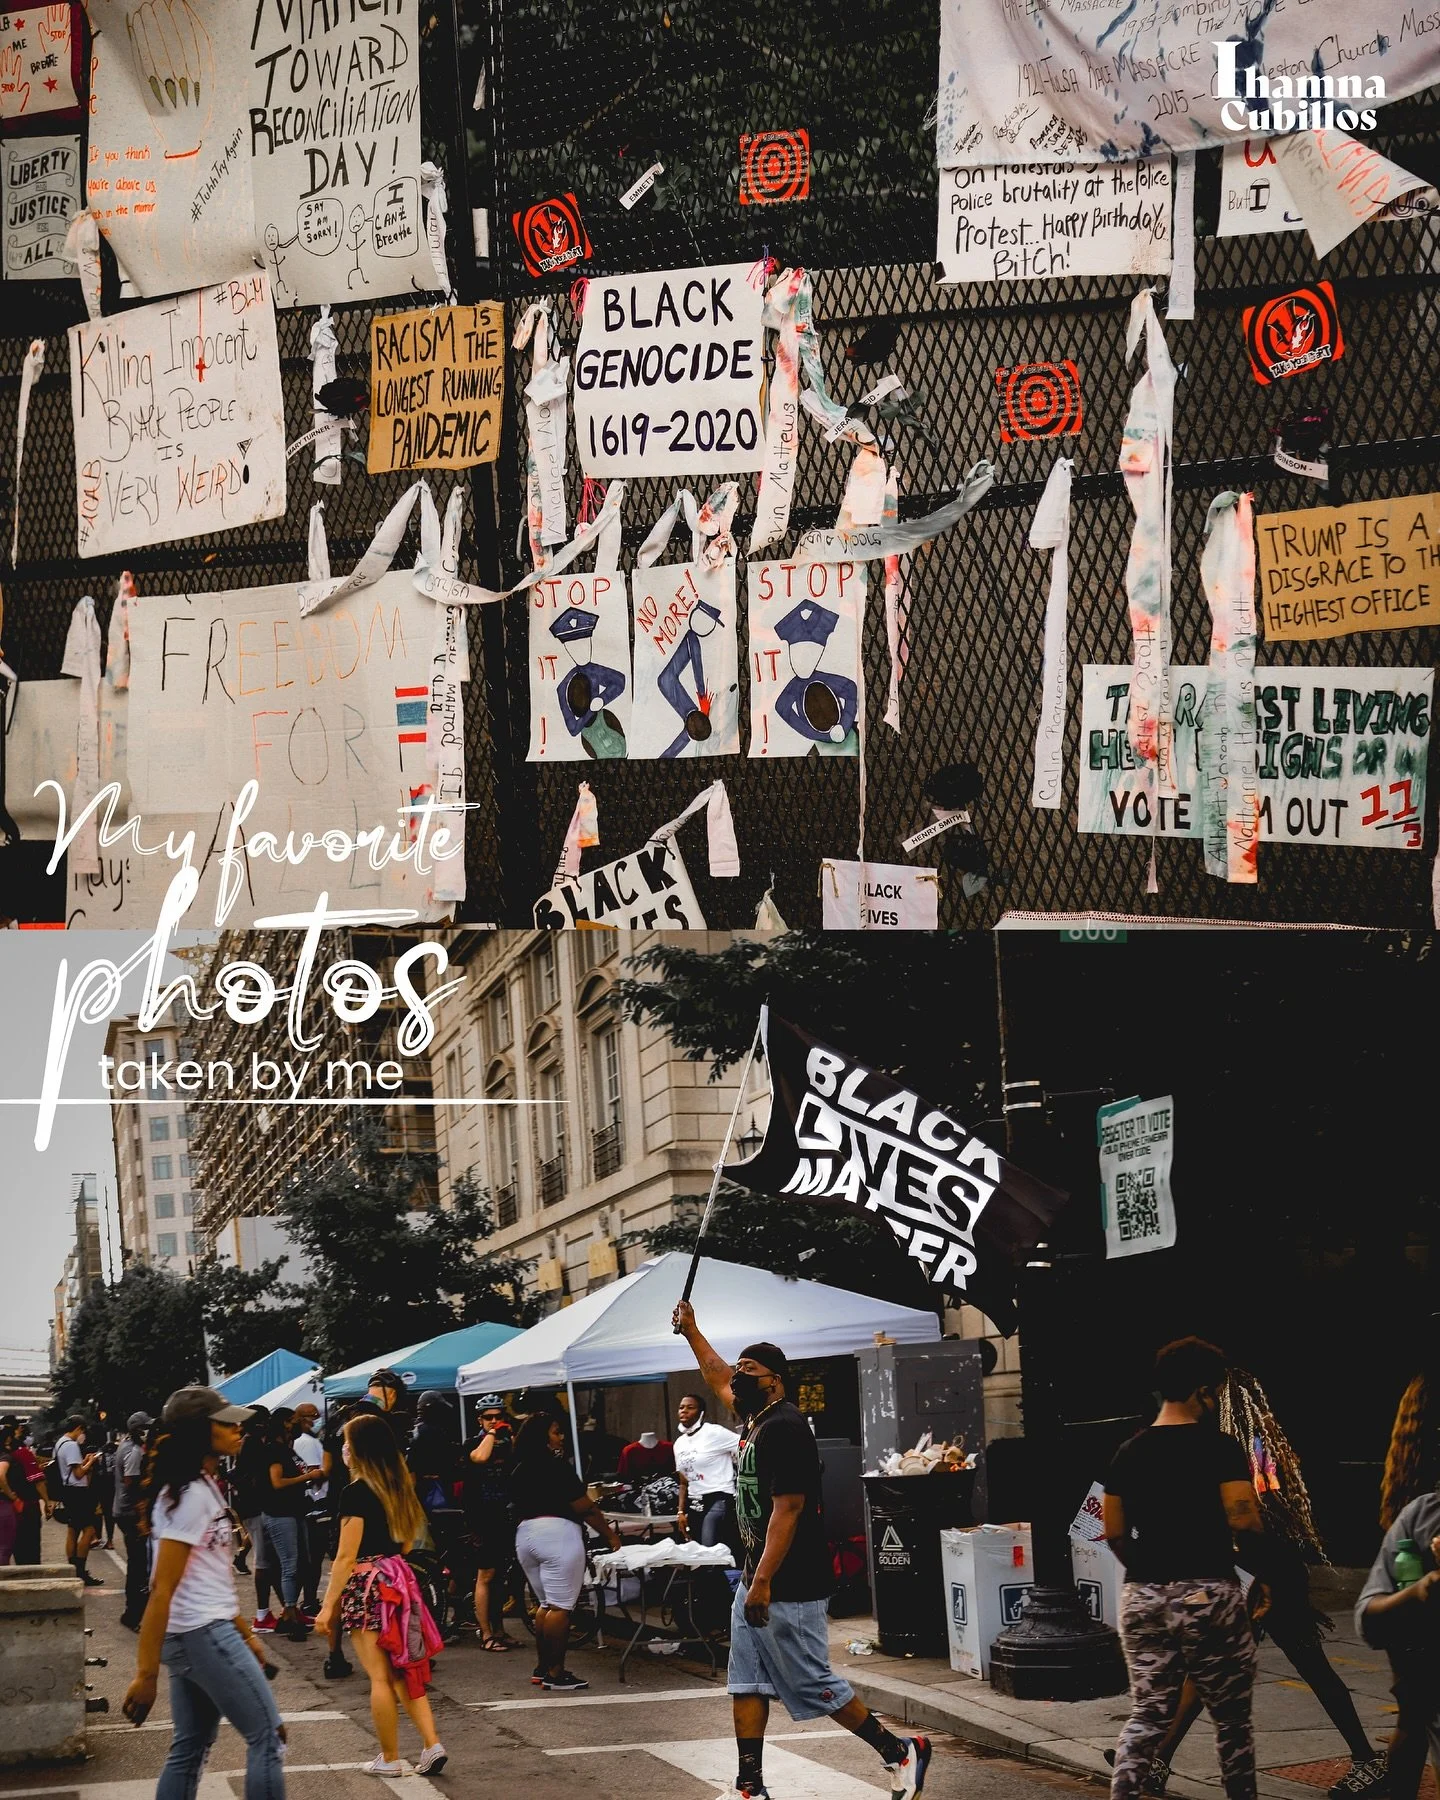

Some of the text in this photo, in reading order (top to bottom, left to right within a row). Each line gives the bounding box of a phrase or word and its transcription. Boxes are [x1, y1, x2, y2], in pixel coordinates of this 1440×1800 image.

[13, 39, 27, 51] ME
[1314, 29, 1393, 72] Church
[255, 23, 409, 108] TOWARD
[11, 151, 70, 186] LIBERTY
[105, 152, 119, 168] you
[125, 145, 150, 160] think
[115, 177, 140, 190] above
[387, 183, 404, 206] I
[1002, 178, 1079, 204] brutality
[1084, 176, 1104, 197] at
[1112, 170, 1134, 195] the
[1228, 190, 1250, 210] But
[9, 195, 70, 226] JUSTICE
[306, 202, 324, 217] SAY
[316, 217, 328, 227] AM
[1043, 208, 1089, 240] Happy
[307, 221, 338, 243] SORRY!
[375, 227, 413, 249] Breathe
[24, 239, 54, 264] ALL
[604, 278, 734, 332] BLACK
[376, 308, 491, 371] RACISM IS
[464, 329, 498, 362] THE
[78, 330, 156, 418] Killing
[576, 340, 754, 390] GENOCIDE
[377, 366, 502, 417] LONGEST RUNNING
[169, 388, 236, 432] PEOPLE
[303, 425, 331, 446] TURNER
[391, 410, 491, 468] PANDEMIC
[590, 408, 757, 458] 1619-2020
[157, 443, 184, 461] IS
[105, 471, 160, 526] VERY
[1264, 512, 1430, 564] TRUMP IS A
[757, 563, 855, 601] STOP
[1267, 555, 1373, 595] DISGRACE
[1380, 552, 1406, 579] TO
[534, 578, 611, 608] STOP
[1267, 584, 1430, 632] HIGHEST OFFICE
[636, 595, 658, 633] NO
[652, 568, 699, 655] MORE!
[162, 601, 406, 704] FREEDOM
[538, 655, 558, 681] IT
[754, 649, 781, 682] IT
[1314, 687, 1431, 737] LIVING
[253, 704, 368, 786] FOR
[911, 812, 963, 845] HENRY SMITH
[1109, 790, 1191, 831] VOTE
[1286, 797, 1348, 838] OUT
[535, 845, 678, 930] BLACK
[866, 909, 898, 926] IVES
[806, 1047, 1006, 1183] BLACK
[1148, 1109, 1170, 1132] VOTE
[879, 1556, 910, 1565] GOLDEN
